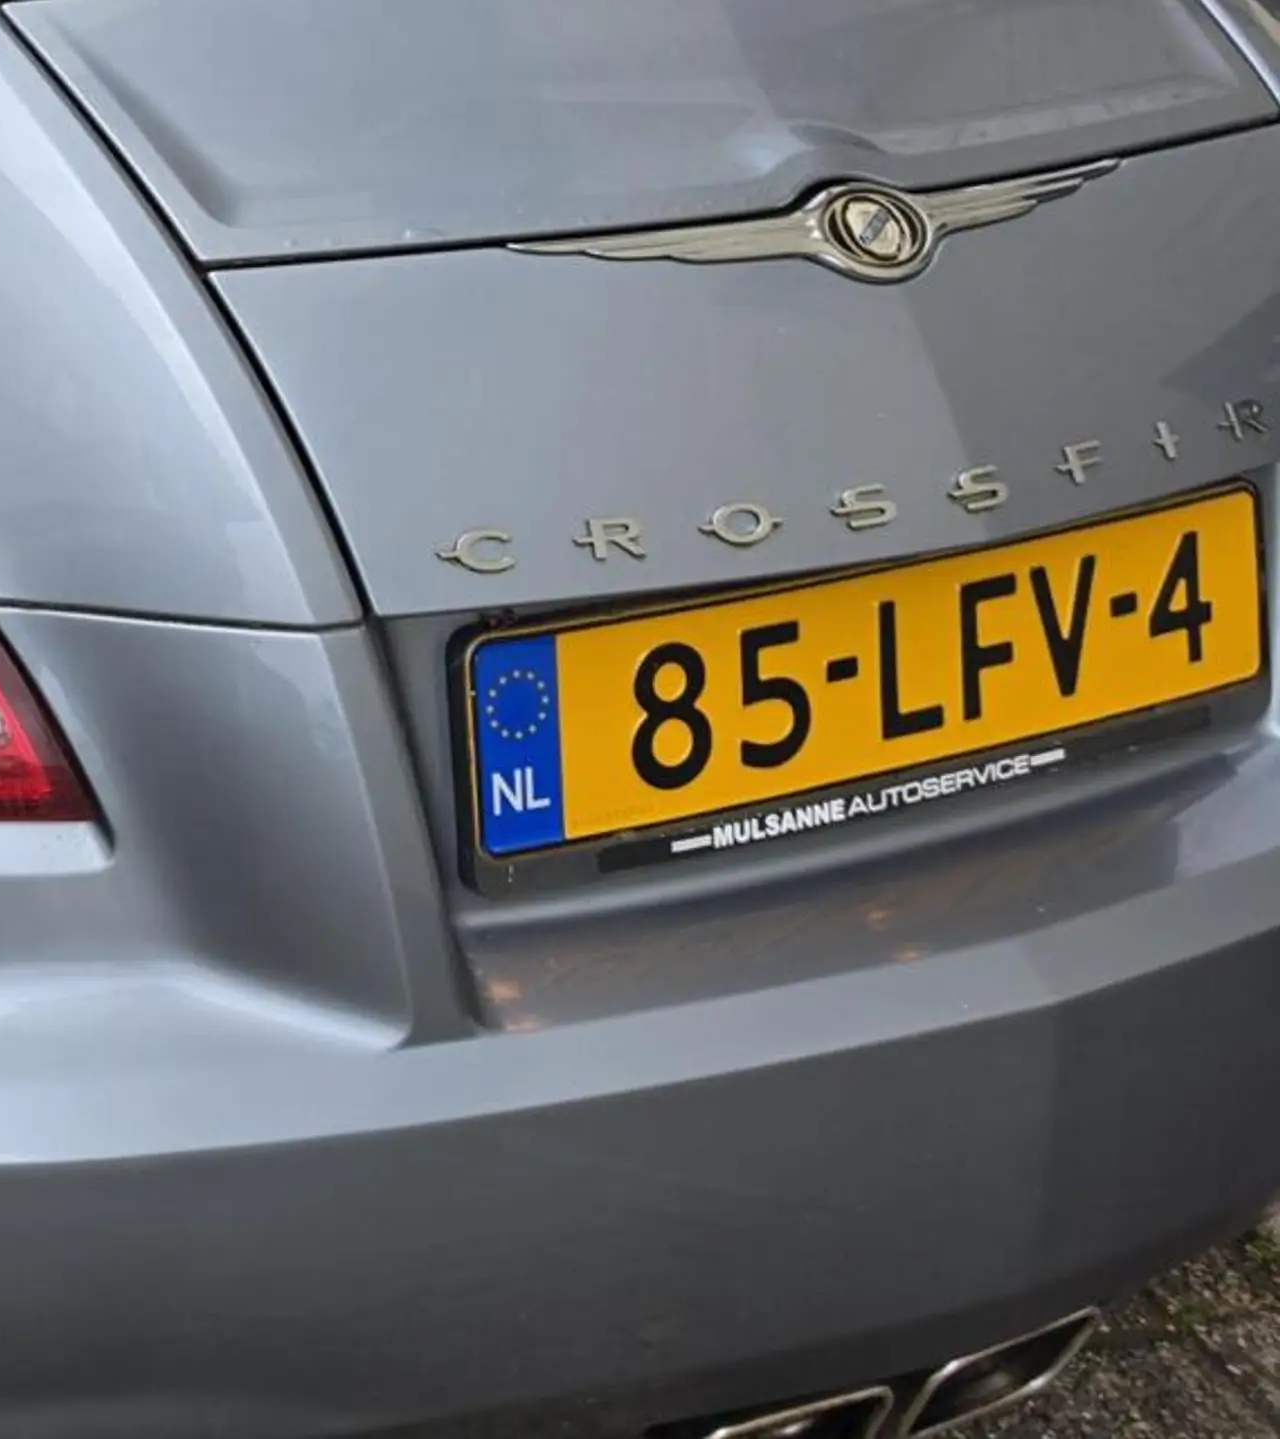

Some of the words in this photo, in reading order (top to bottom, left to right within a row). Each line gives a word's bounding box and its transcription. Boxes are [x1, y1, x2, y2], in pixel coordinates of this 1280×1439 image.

[631, 530, 1213, 791] 85-LFV-4
[491, 764, 550, 817] NL
[712, 797, 848, 849] MULSANNE
[847, 754, 1031, 817] AUTOSERVICE
